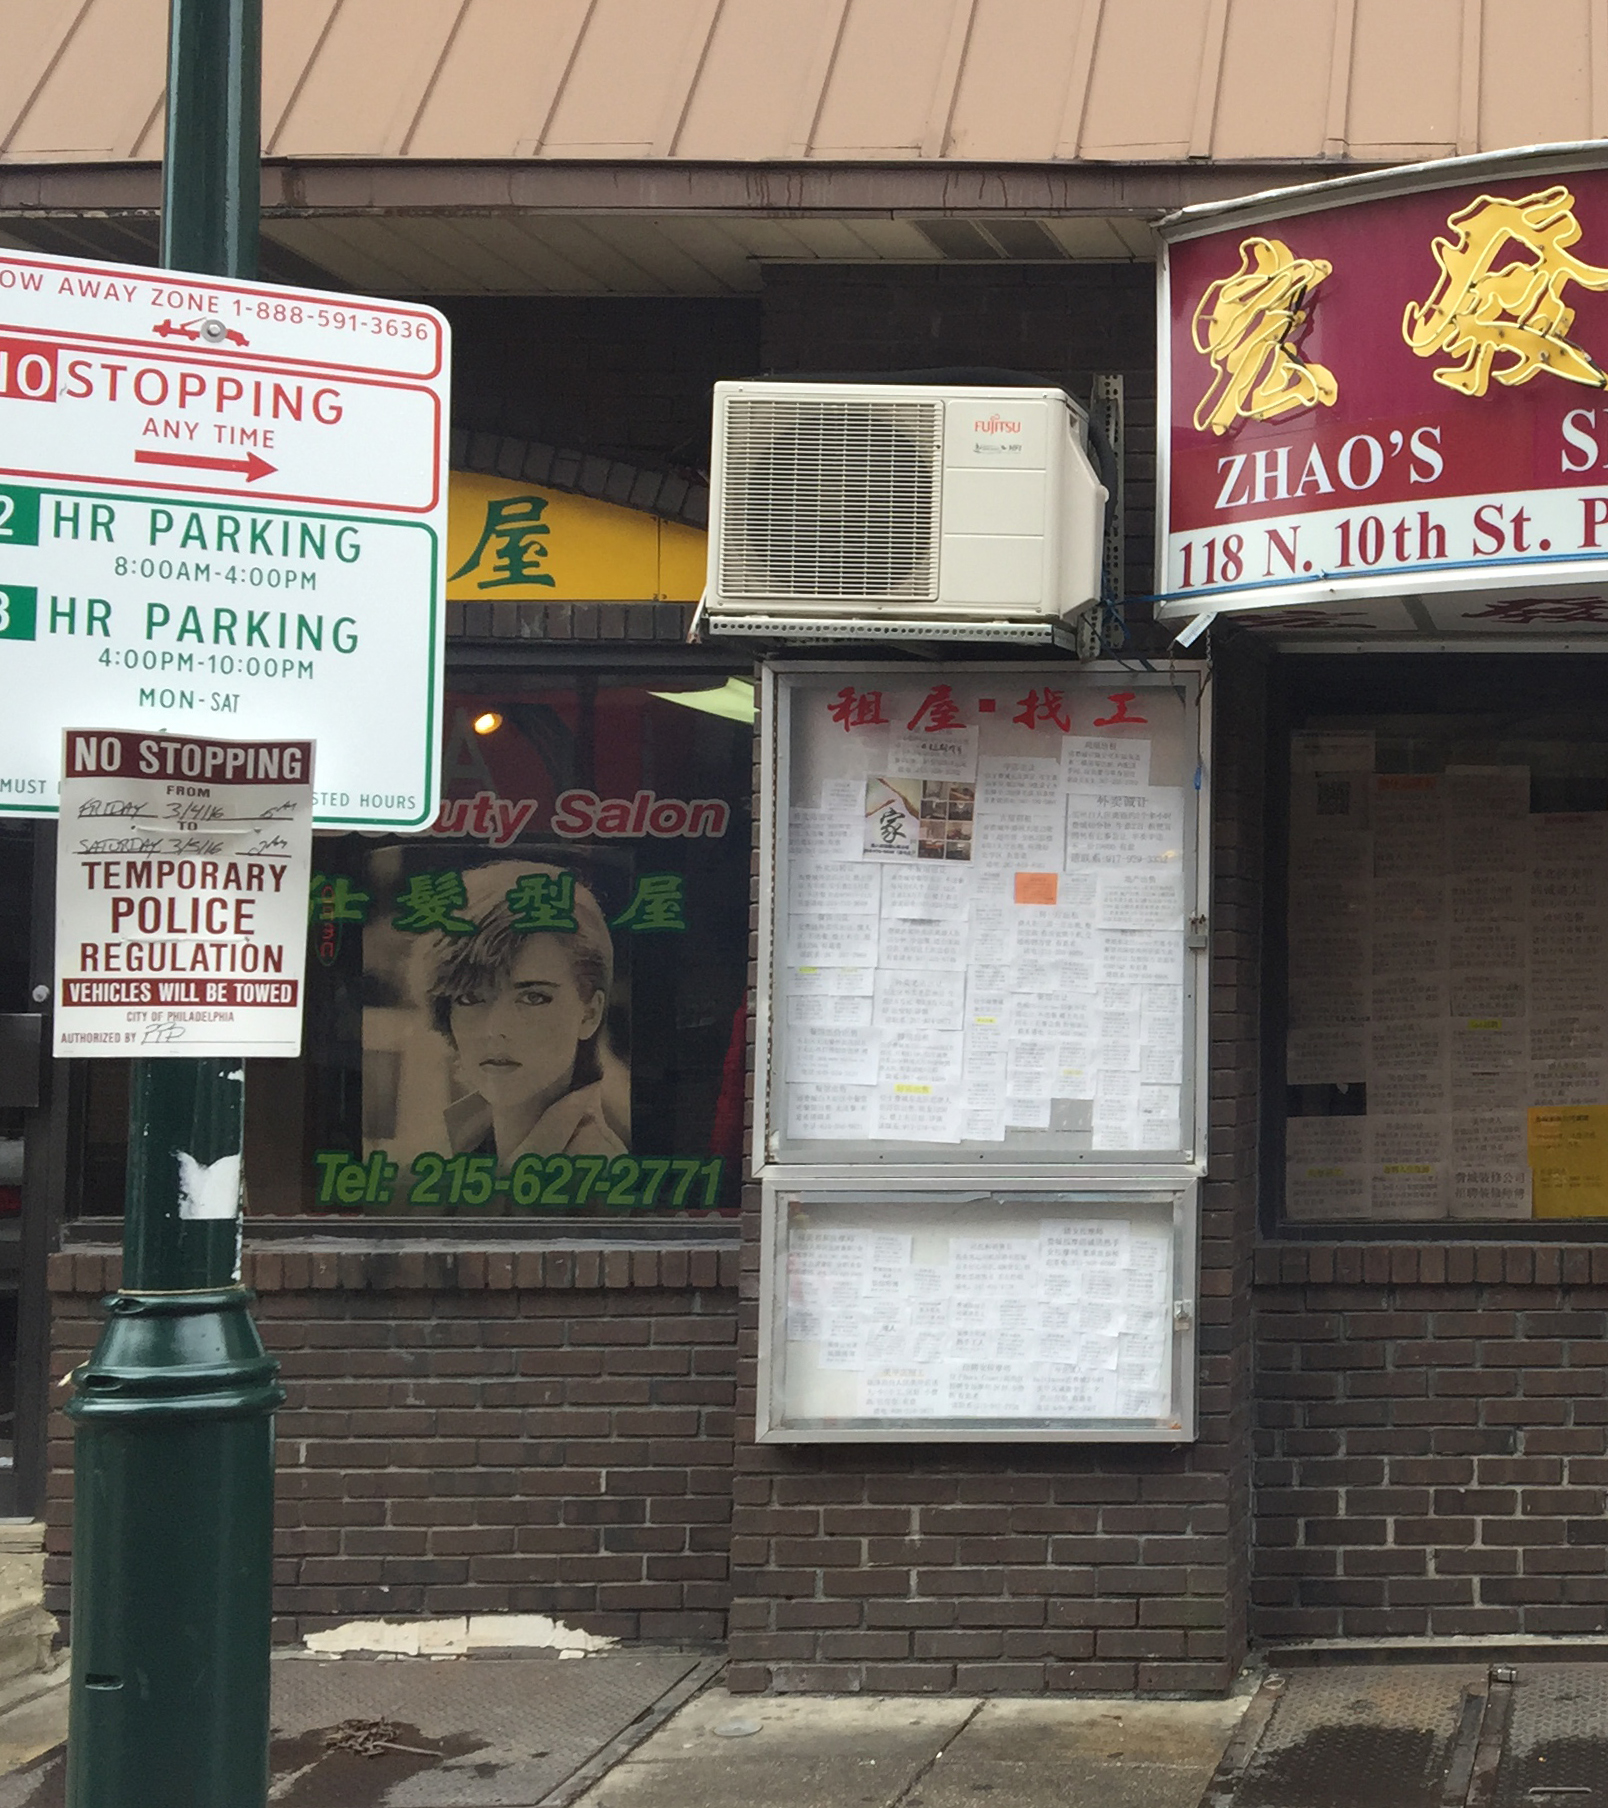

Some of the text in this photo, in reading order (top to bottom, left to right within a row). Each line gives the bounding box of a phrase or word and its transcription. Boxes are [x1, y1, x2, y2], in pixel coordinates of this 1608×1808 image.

[0, 269, 429, 341] OW AWAY ZONE 1-888-591-3636
[65, 359, 345, 426] STOPPING
[142, 417, 276, 450] ANY TIME
[974, 413, 1021, 435] FUJITSU
[1213, 426, 1445, 510] ZHAO'S
[53, 500, 116, 543] HR
[150, 508, 362, 564] PARKING
[447, 495, 556, 591] 屋
[1179, 533, 1243, 590] 118
[1263, 526, 1313, 577] N.
[1333, 510, 1448, 568] 10th
[1471, 503, 1551, 557] St.
[113, 556, 317, 591] 8:00AM-4:00PM
[49, 595, 112, 638] HR
[145, 602, 359, 654] PARKING
[98, 647, 315, 680] 4:00PM-10:00PM
[74, 736, 302, 780] NO STOPPING
[0, 778, 47, 795] MUST
[166, 784, 211, 798] FROM
[312, 791, 416, 811] STED HOURS
[177, 820, 198, 831] TO
[431, 790, 538, 848] uty
[551, 788, 731, 838] Salon
[879, 807, 907, 843] 家
[79, 837, 161, 857] SATURDAY
[81, 859, 288, 893] TEMPORARY
[111, 896, 256, 935] POLICE
[80, 942, 284, 974] REGULATION
[69, 981, 293, 1004] VEHICLES WILL BE TOWED
[126, 1011, 235, 1023] CITY OF PHILADELPHIA
[61, 1032, 136, 1044] AUTHORIZED BY
[315, 1151, 725, 1209] Tel: 215-627-2771
